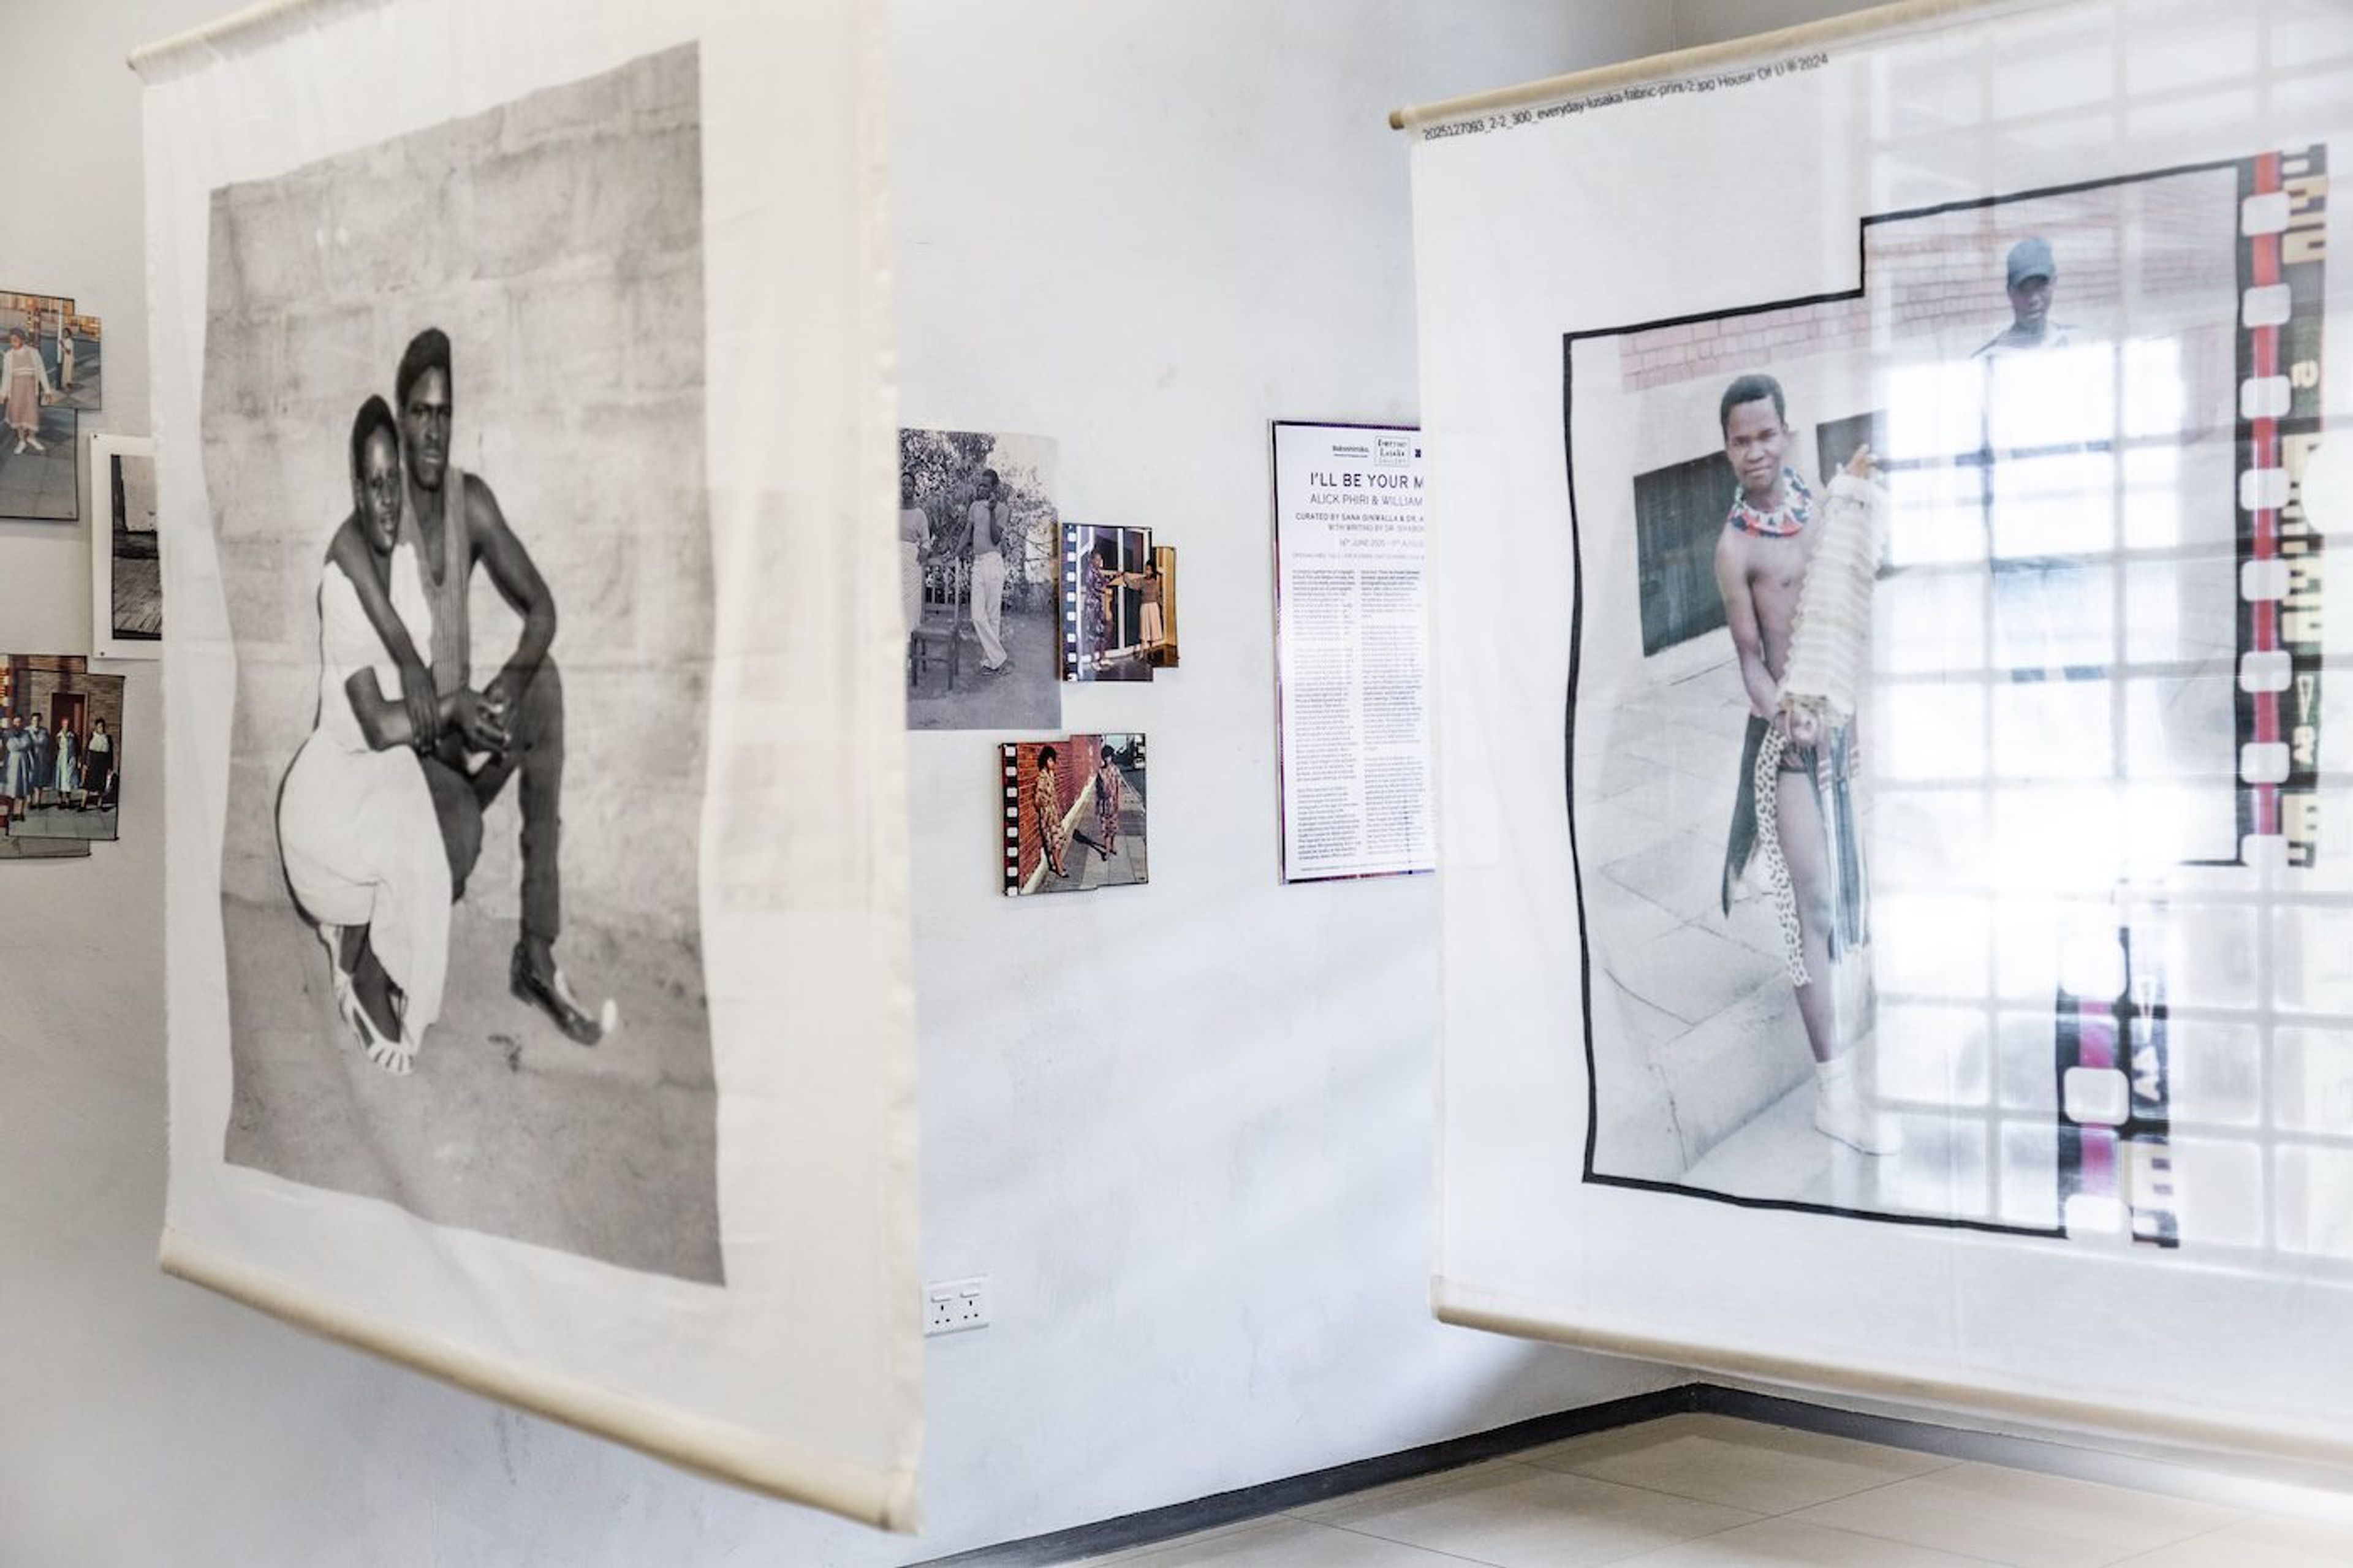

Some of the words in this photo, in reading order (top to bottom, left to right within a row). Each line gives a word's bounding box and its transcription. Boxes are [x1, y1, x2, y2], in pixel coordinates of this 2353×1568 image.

[1718, 72, 1755, 88] House
[1757, 66, 1772, 80] Of
[1797, 53, 1828, 70] 2024
[1310, 472, 1337, 487] I'LL
[1343, 474, 1362, 487] BE
[1367, 474, 1408, 489] YOUR
[1414, 476, 1424, 489] M
[1310, 493, 1339, 505] ALICK
[1343, 494, 1369, 505] PHIRI
[1371, 495, 1379, 506] &
[1381, 496, 1423, 507] WILLIAM
[1295, 512, 1328, 521] CURATED
